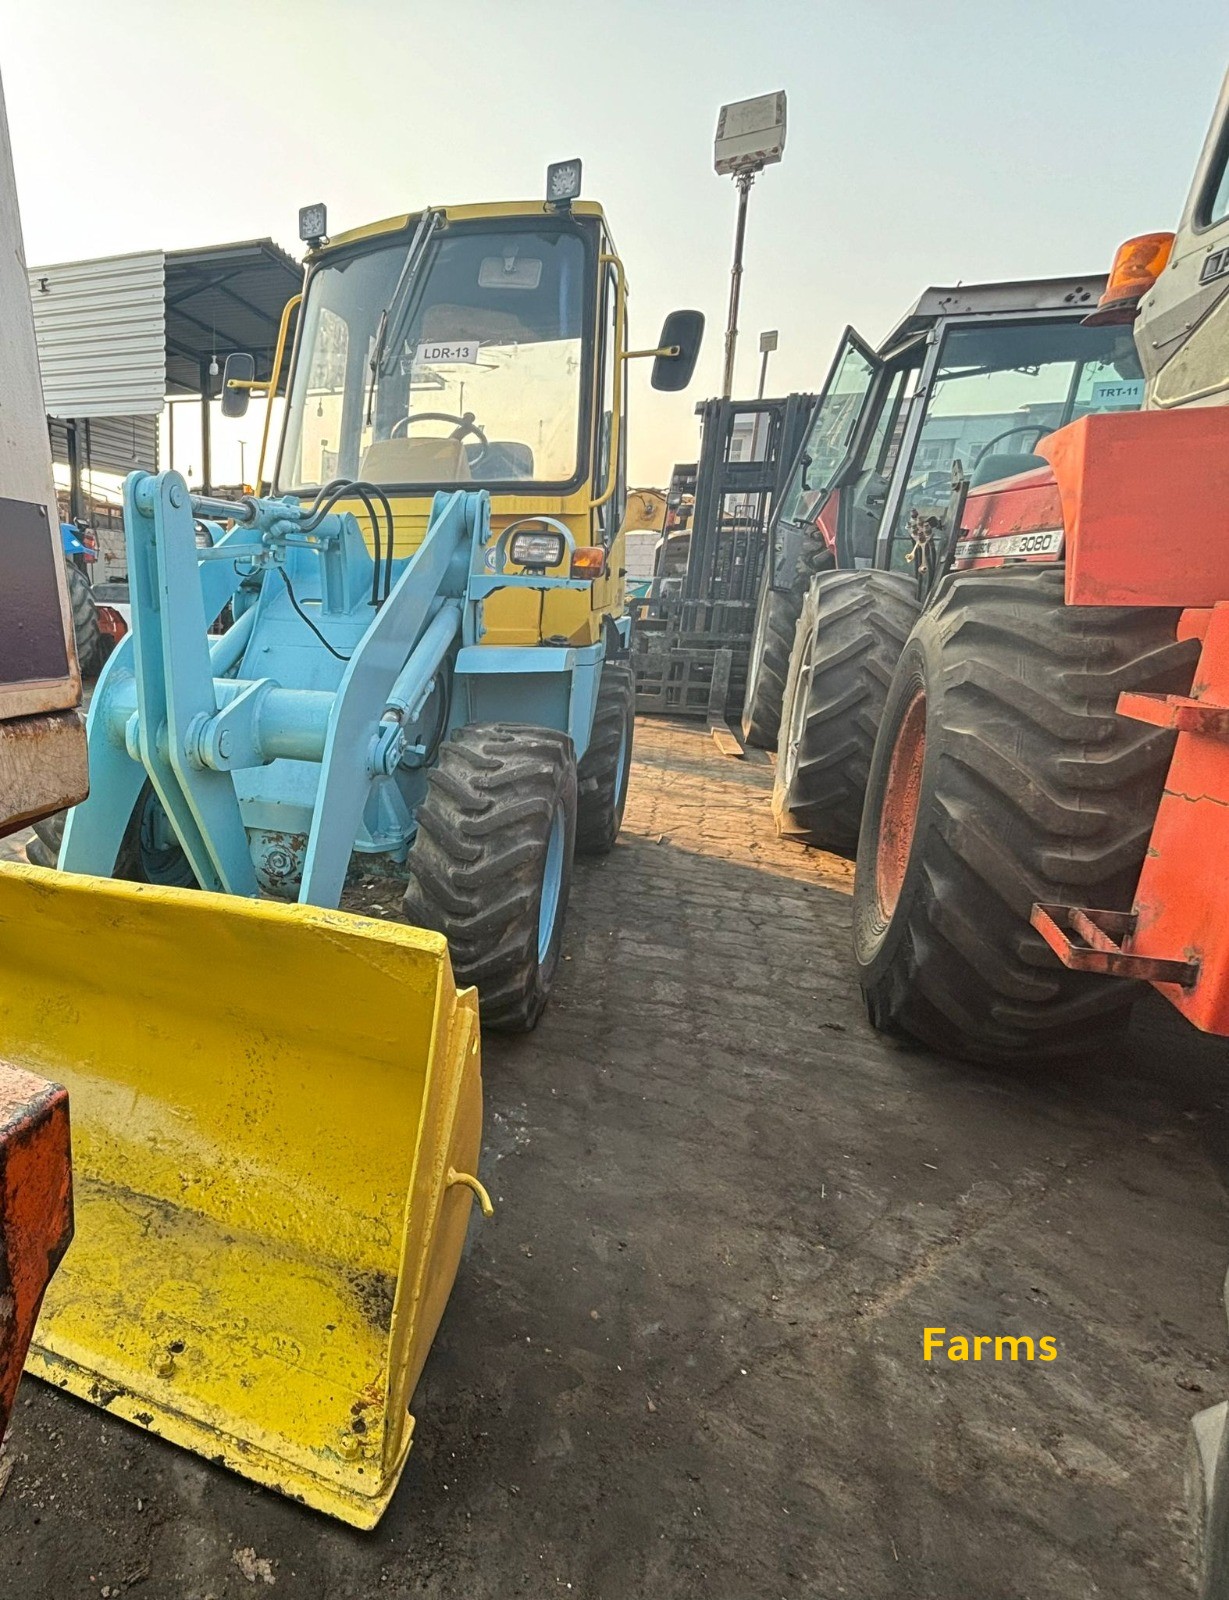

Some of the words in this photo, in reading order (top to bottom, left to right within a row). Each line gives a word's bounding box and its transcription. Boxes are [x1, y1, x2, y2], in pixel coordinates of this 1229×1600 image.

[424, 347, 470, 359] LDR-13
[1098, 386, 1139, 398] TRT-11
[1018, 534, 1052, 553] 3080
